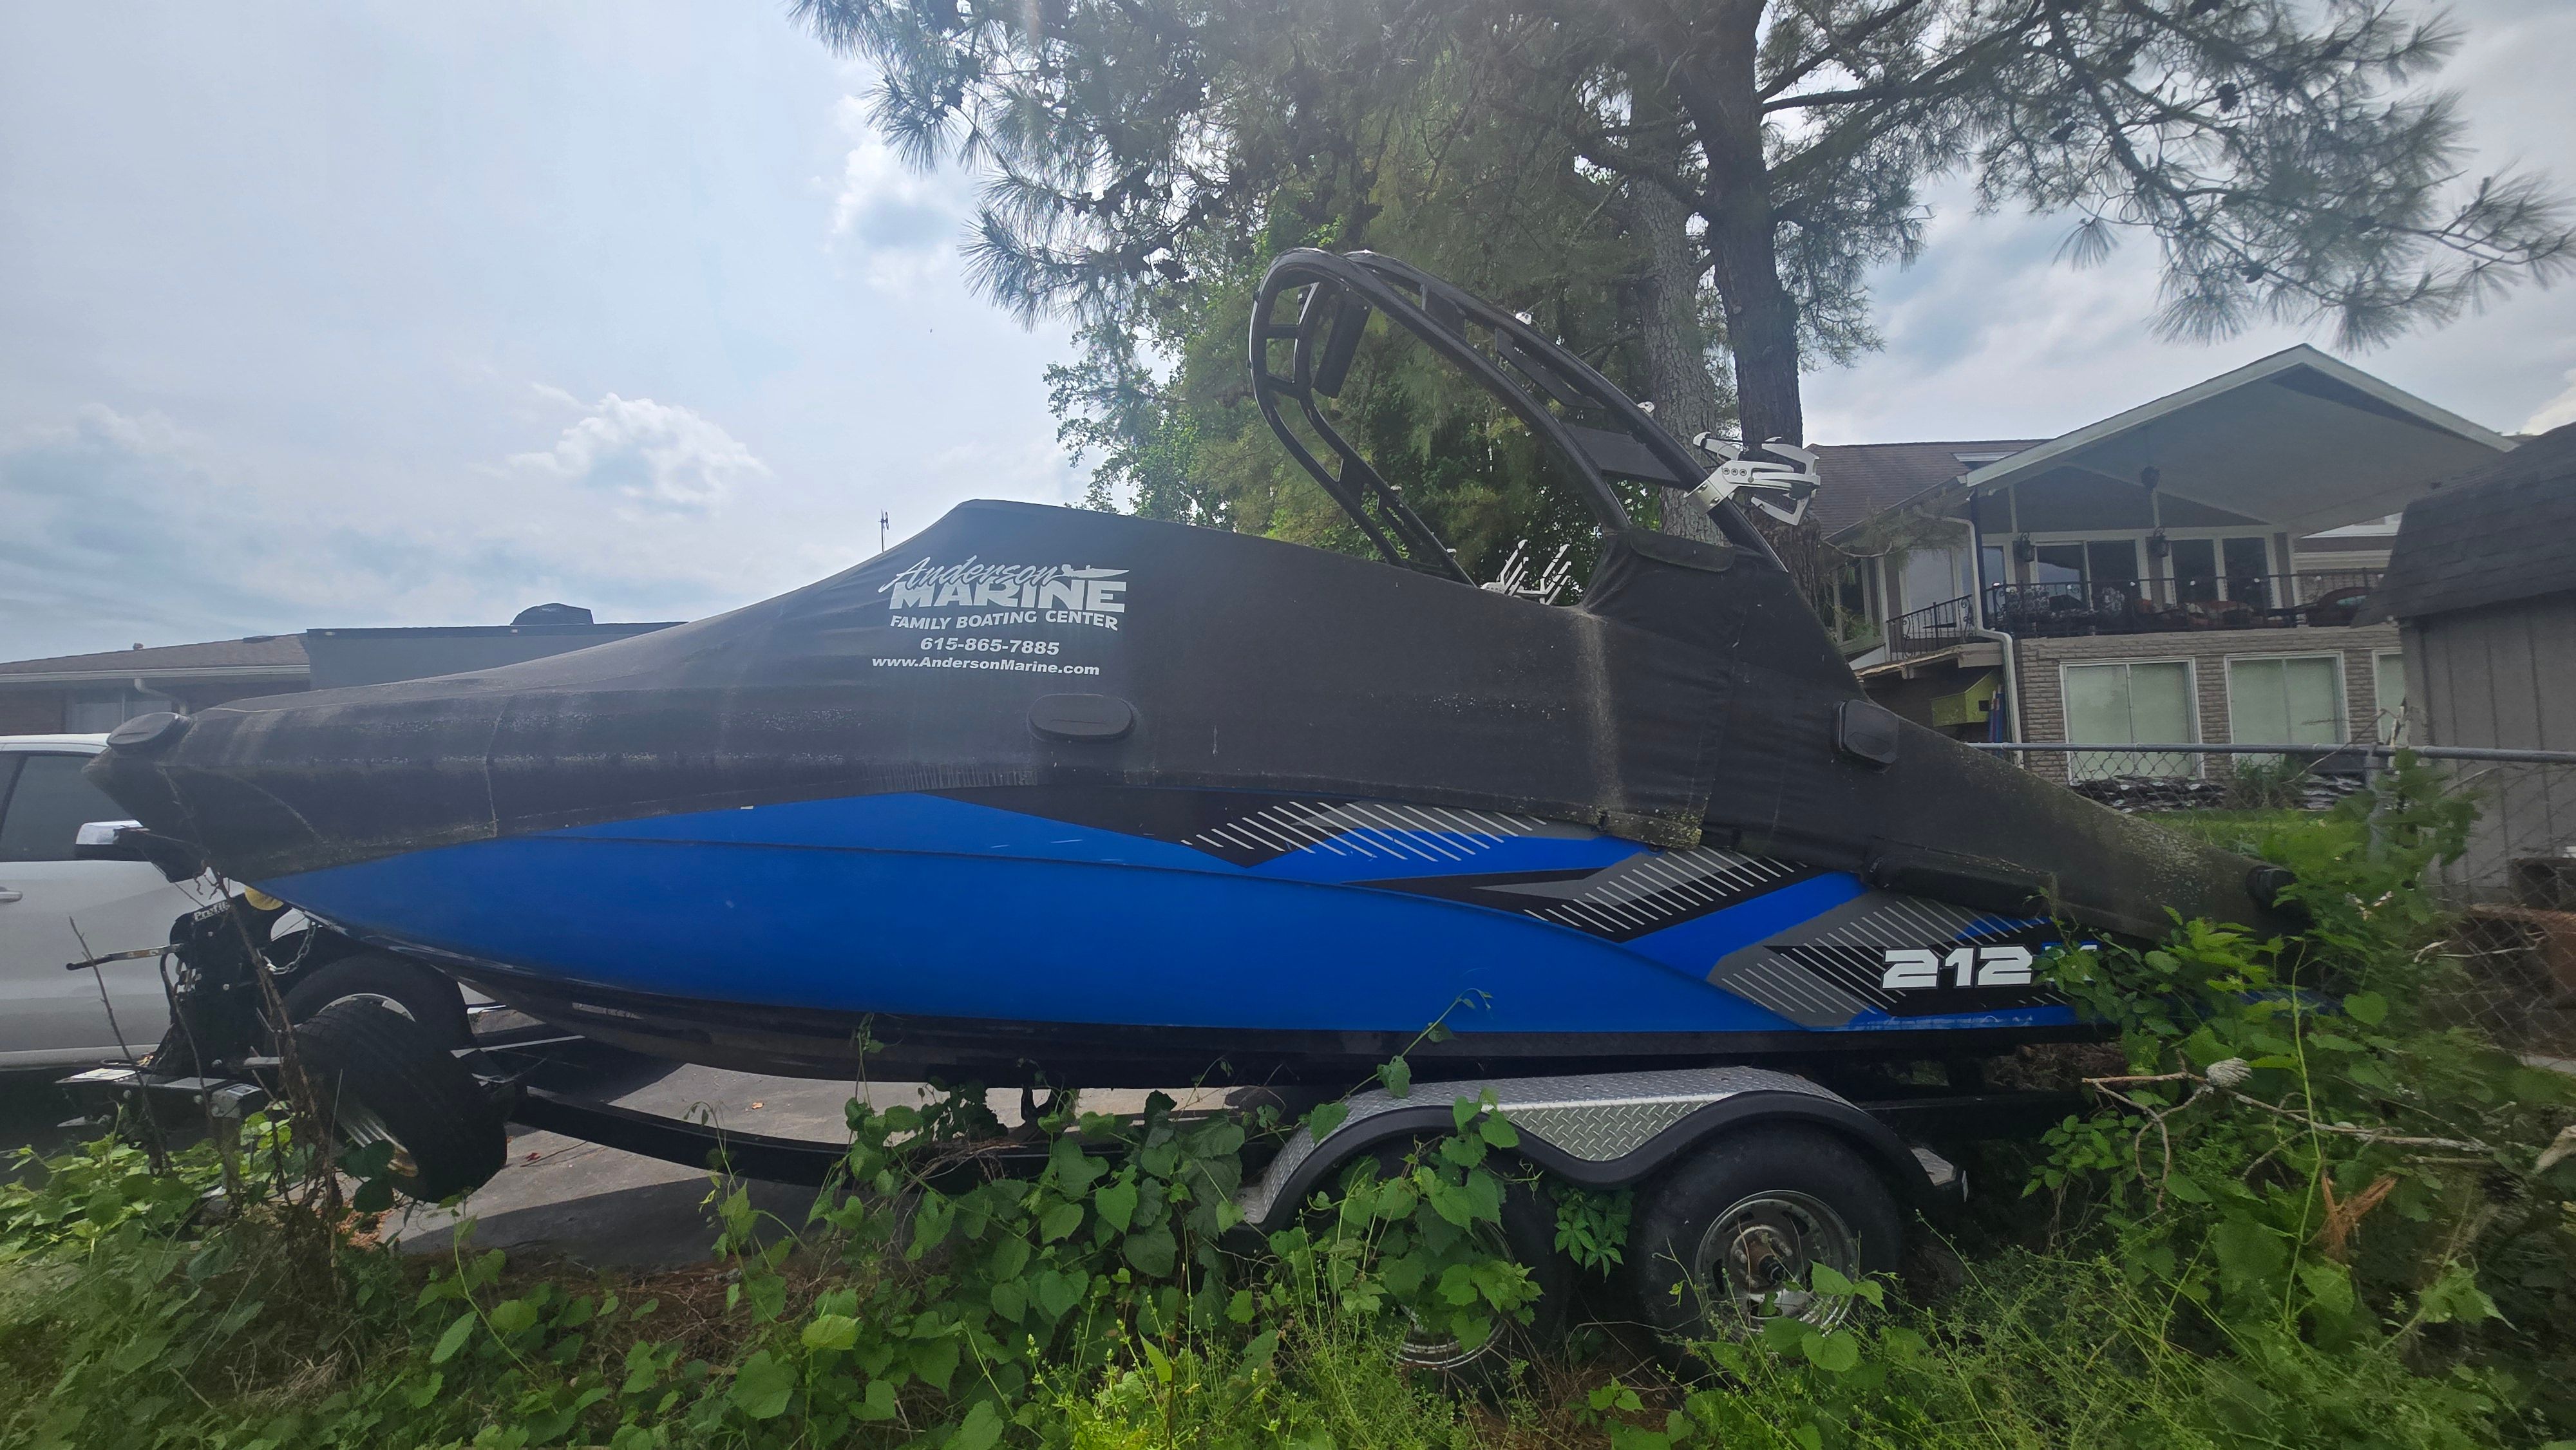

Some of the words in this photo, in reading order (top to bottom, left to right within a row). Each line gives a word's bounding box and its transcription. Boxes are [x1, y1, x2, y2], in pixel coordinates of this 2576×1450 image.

[878, 555, 1063, 593] Anderson
[889, 579, 1126, 613] MARINE
[890, 616, 951, 630] FAMILY
[956, 610, 1037, 628] BOATING
[1045, 610, 1118, 631] CENTER
[920, 637, 1060, 655] 615-865-7885
[872, 657, 1100, 675] www.AndersonMarine.com
[1882, 945, 2098, 988] 212
